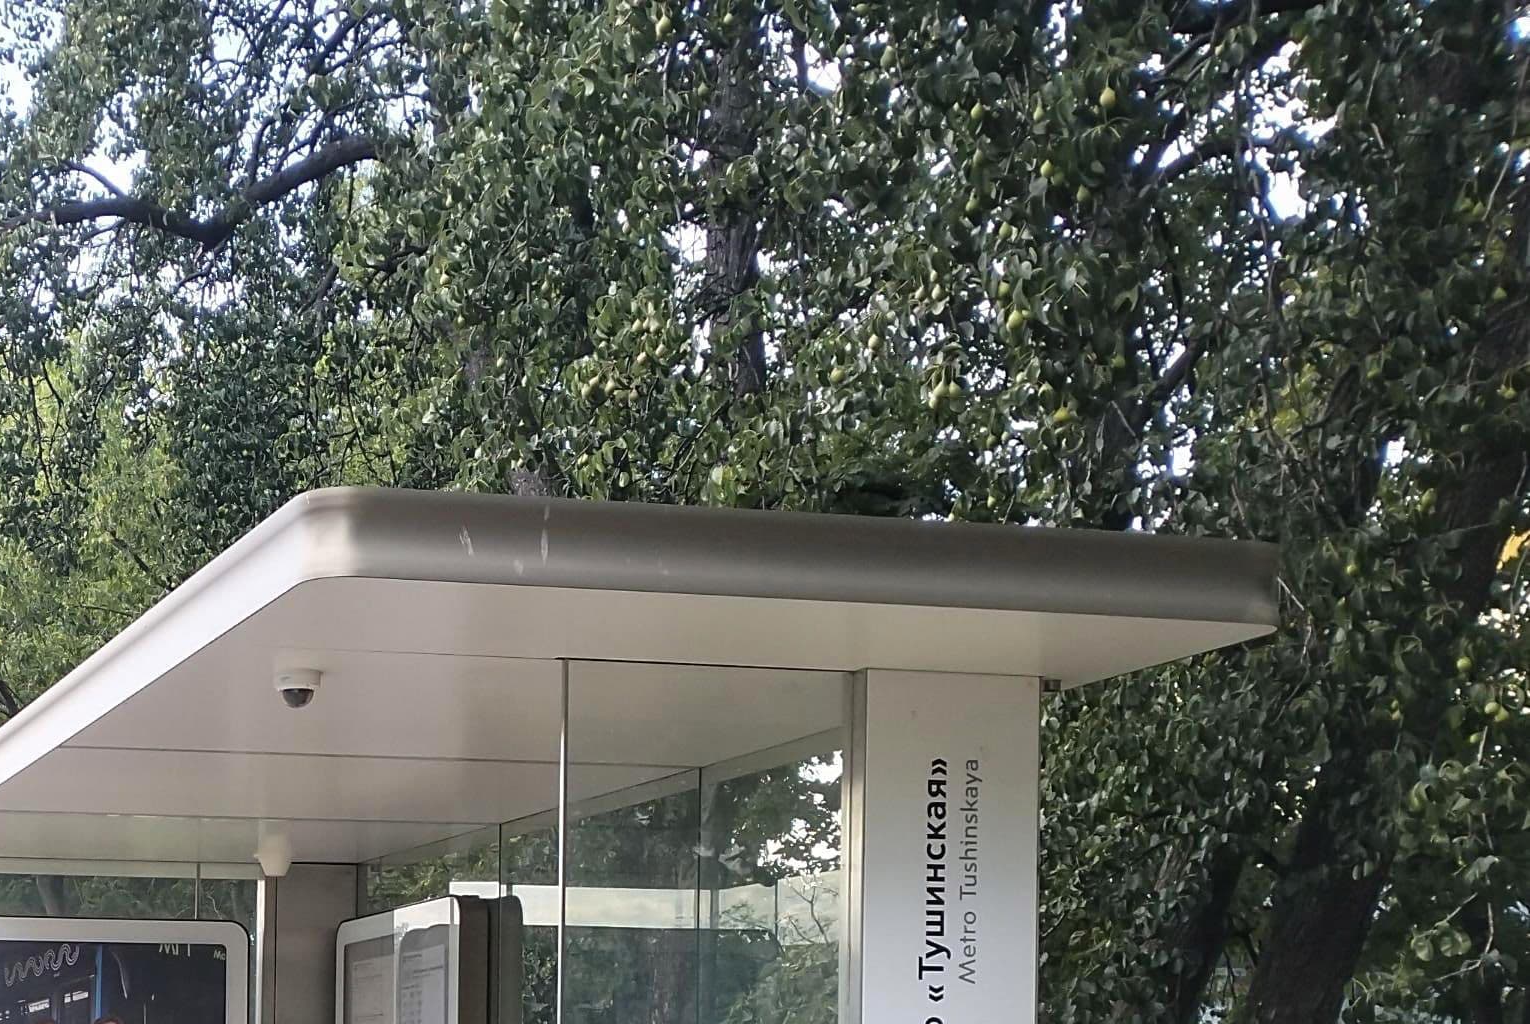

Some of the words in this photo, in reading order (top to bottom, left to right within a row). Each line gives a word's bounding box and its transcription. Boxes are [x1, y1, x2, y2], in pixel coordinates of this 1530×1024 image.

[918, 758, 952, 1002] «Тушинская»
[958, 758, 983, 901] Tushinskaya
[958, 910, 977, 985] Metro
